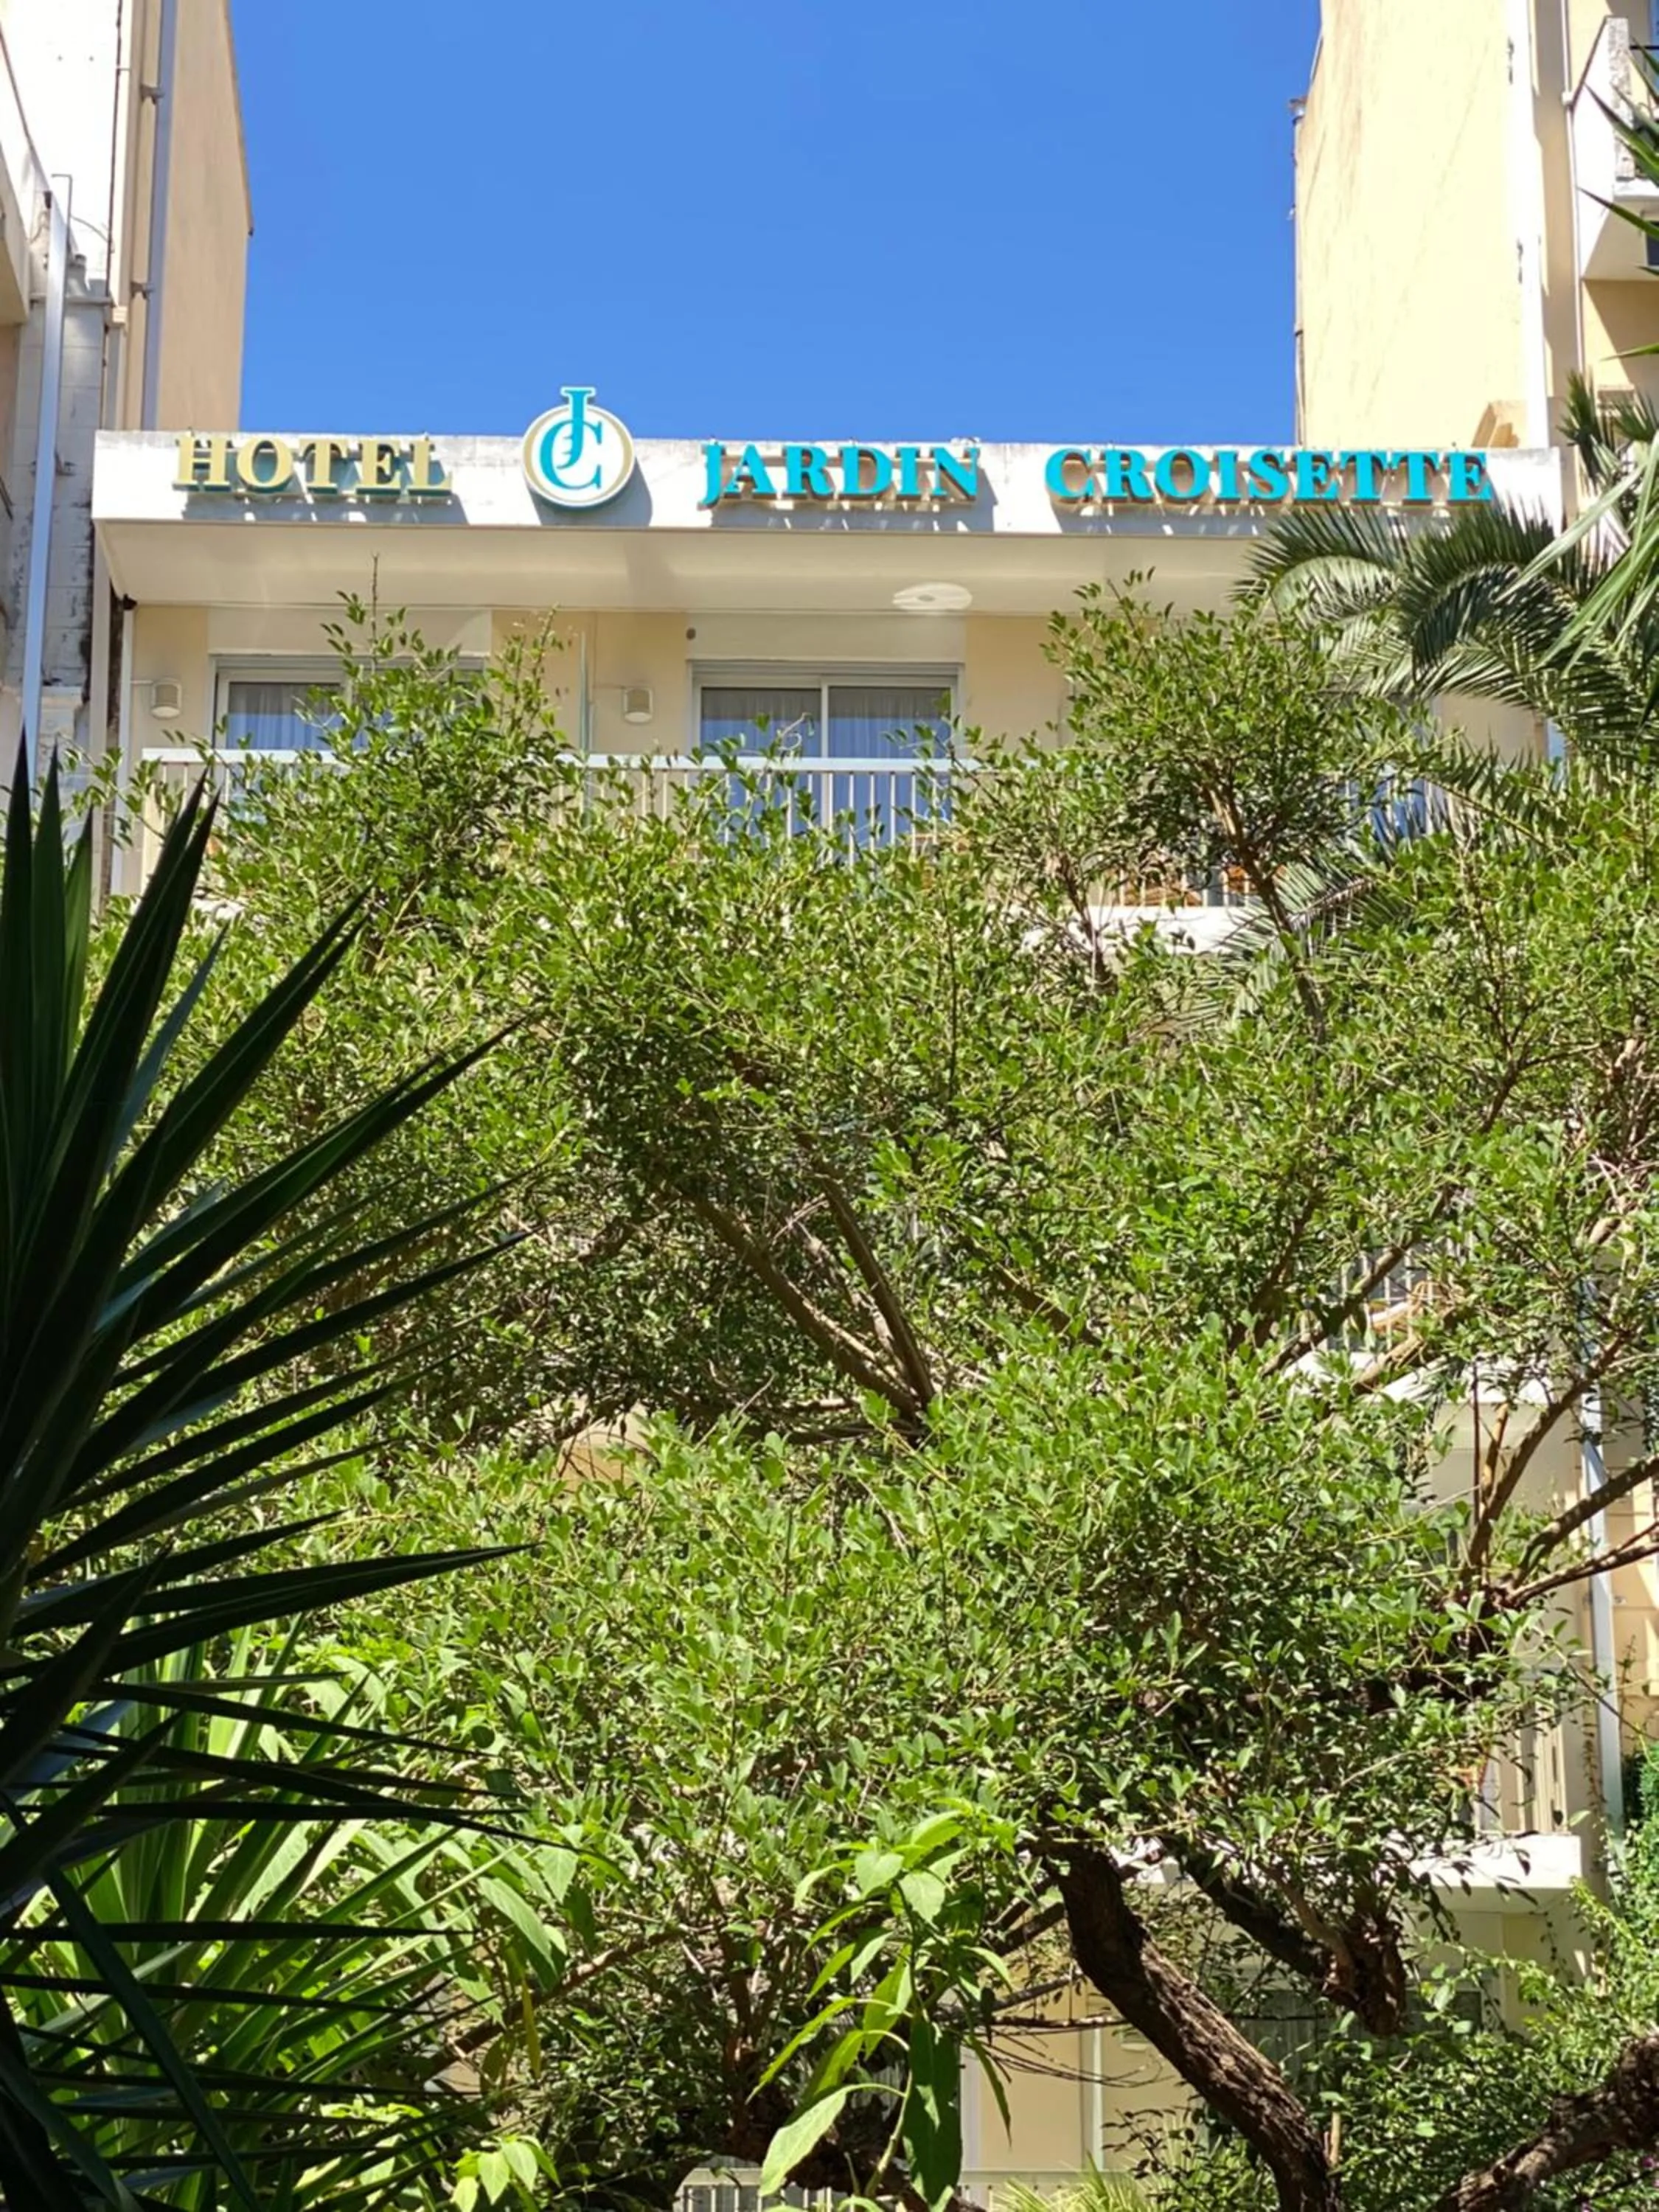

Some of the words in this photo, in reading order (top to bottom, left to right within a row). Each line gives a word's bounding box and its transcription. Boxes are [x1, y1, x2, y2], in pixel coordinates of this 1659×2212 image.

[172, 434, 452, 495] HOTEL
[698, 442, 980, 509] JARDIN
[1045, 448, 1491, 503] CROISETTE
